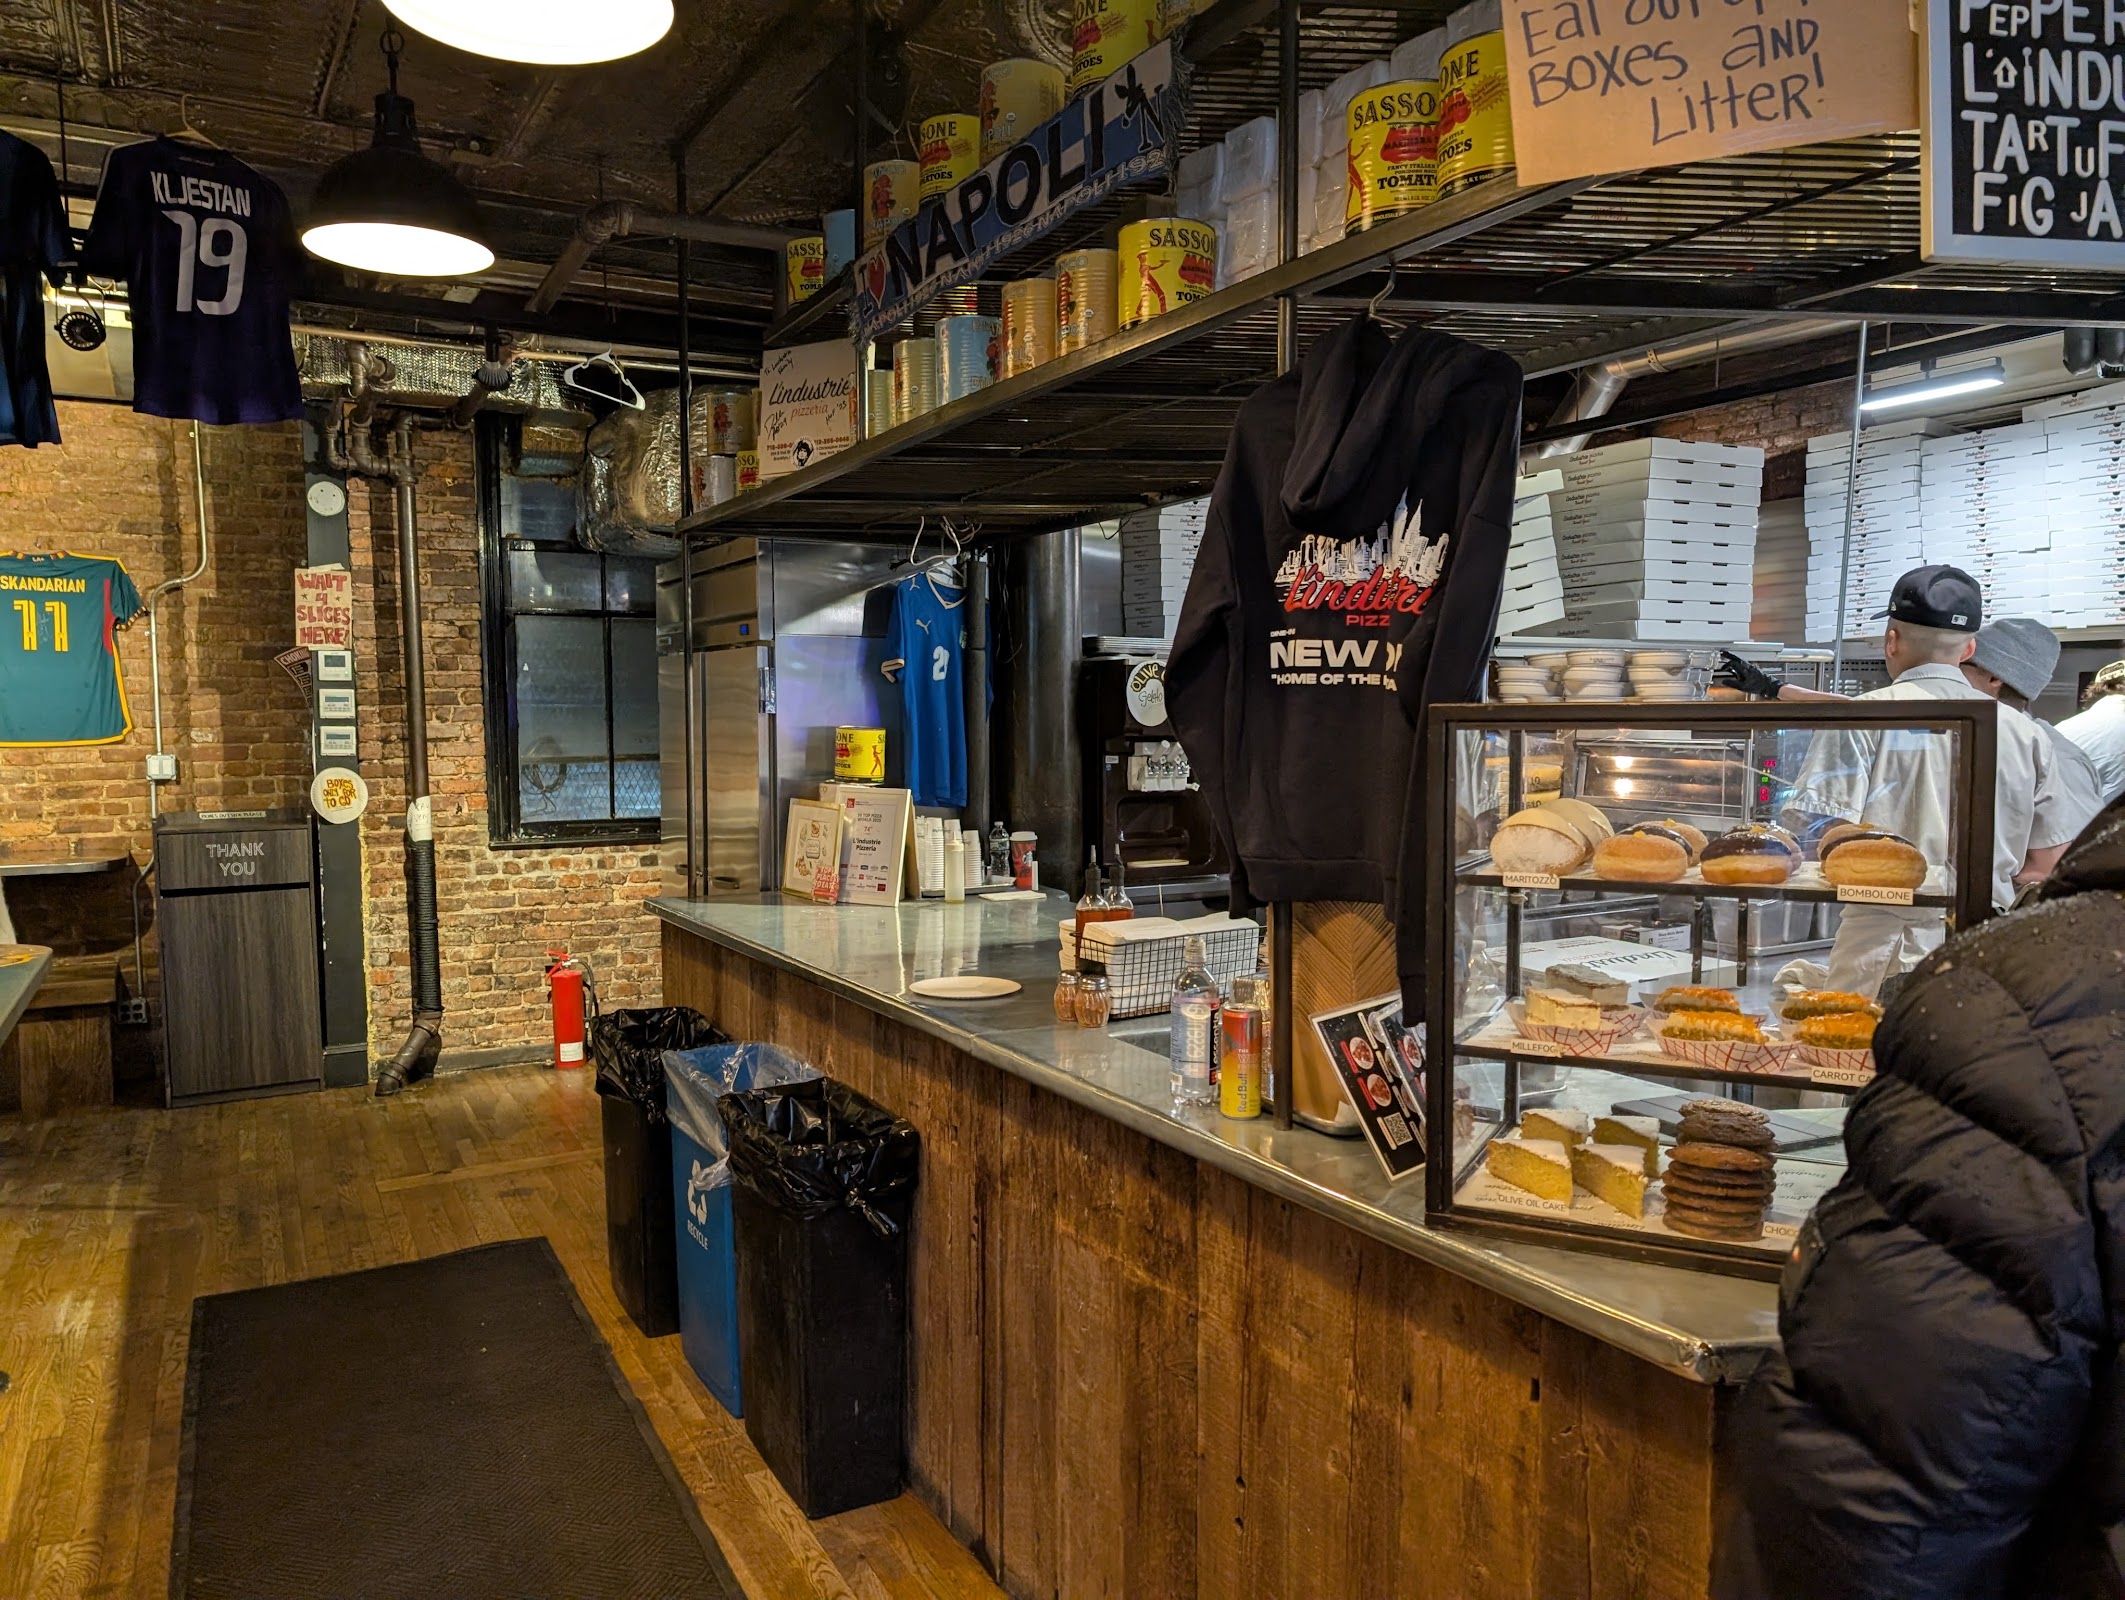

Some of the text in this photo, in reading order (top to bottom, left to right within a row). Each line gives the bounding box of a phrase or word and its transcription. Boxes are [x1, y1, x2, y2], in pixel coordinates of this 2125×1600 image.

[151, 170, 250, 217] KLJESTAN
[885, 85, 1105, 298] NAPOLI
[1972, 171, 2125, 239] FIG JA
[161, 209, 249, 316] 19
[297, 573, 347, 592] WAIT
[316, 592, 328, 605] 4
[297, 605, 350, 625] SLICES
[13, 600, 69, 652] 11
[300, 626, 350, 645] HERE!
[1270, 639, 1379, 669] NEW
[1320, 674, 1344, 685] OF
[1347, 674, 1380, 685] THE
[205, 842, 264, 858] THANK
[219, 861, 256, 877] YOU
[1505, 875, 1557, 885] MARITOZZO
[1840, 888, 1911, 901] BOMBOLONE
[1813, 1069, 1856, 1081] CARROT
[1499, 1193, 1523, 1205] OLIVE
[1526, 1198, 1541, 1208] OIL
[1542, 1201, 1567, 1212] CAKE
[687, 1219, 709, 1250] RECYCLE
